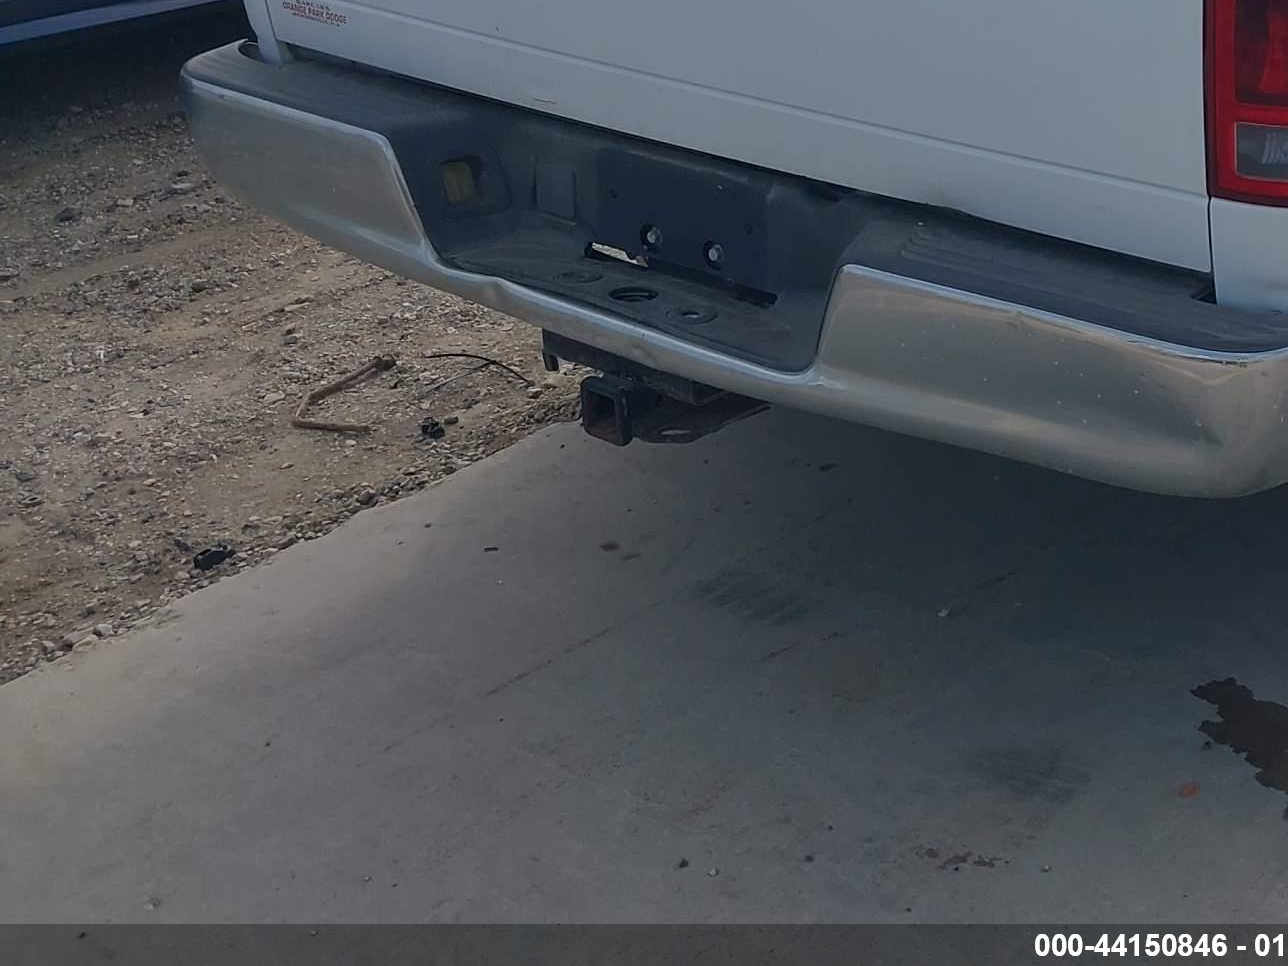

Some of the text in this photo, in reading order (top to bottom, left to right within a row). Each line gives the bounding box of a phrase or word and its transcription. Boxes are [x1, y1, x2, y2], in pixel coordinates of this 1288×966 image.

[282, 1, 307, 16] ORANGE
[307, 7, 325, 19] PARK
[325, 11, 347, 25] DODGE
